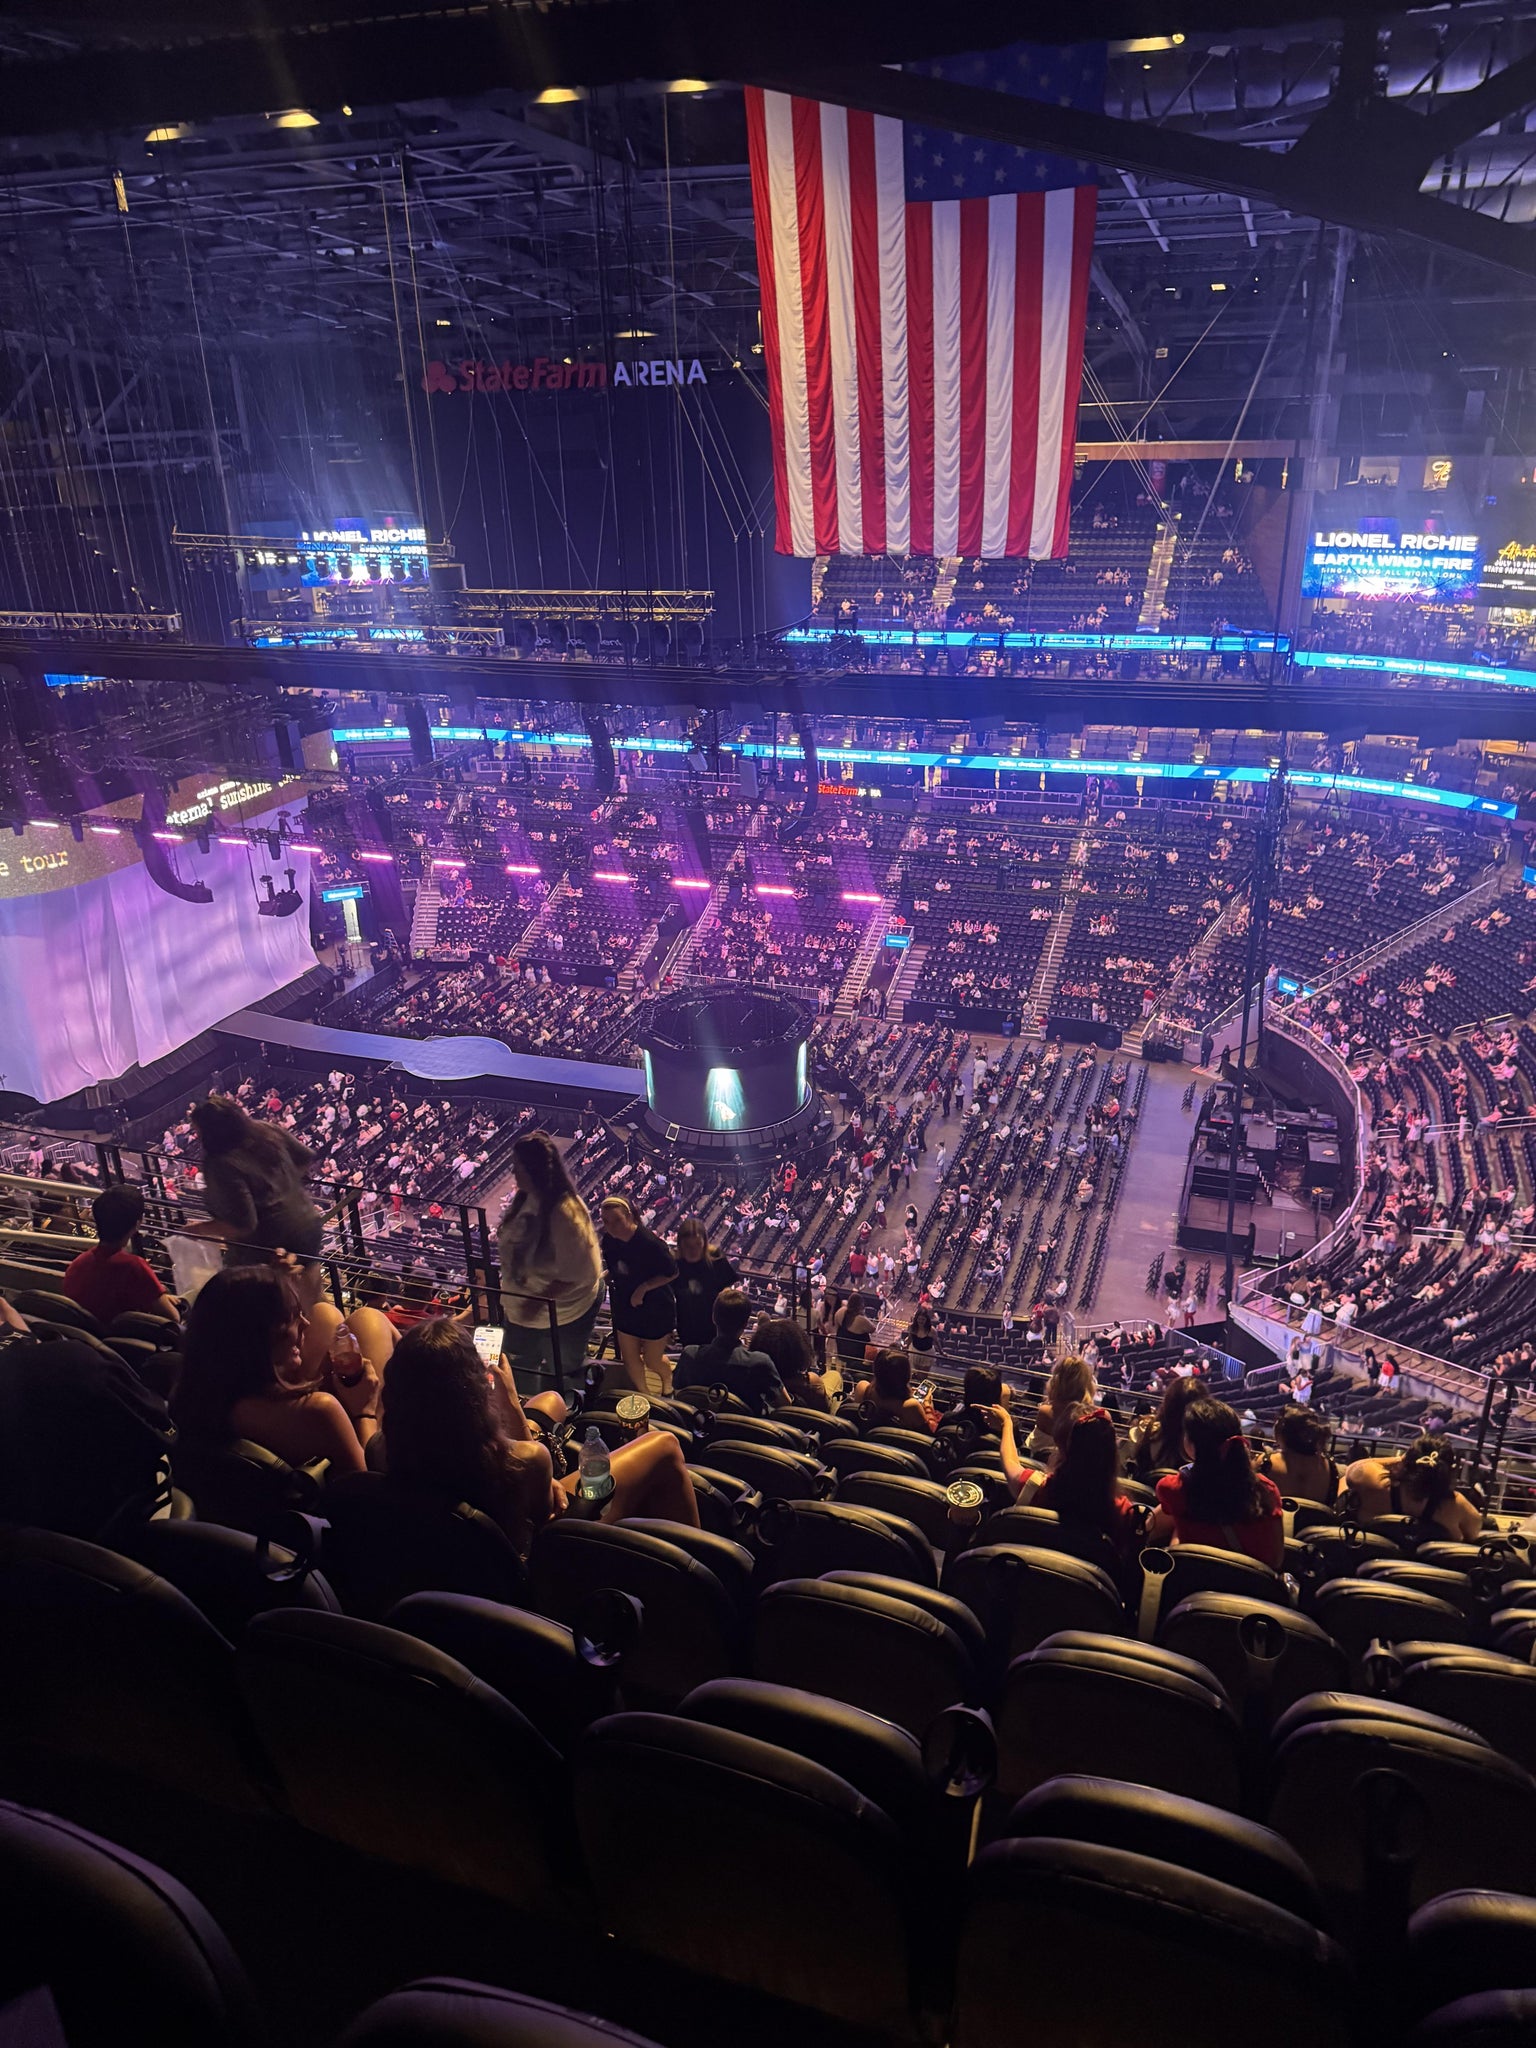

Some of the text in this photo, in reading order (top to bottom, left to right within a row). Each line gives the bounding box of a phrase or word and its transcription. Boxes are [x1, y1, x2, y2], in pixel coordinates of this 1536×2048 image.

[614, 360, 708, 386] ARENA
[370, 529, 427, 541] RICHIE
[1315, 532, 1395, 549] LIONEL
[1400, 534, 1478, 552] RICHIE
[1377, 555, 1422, 568] WIND
[1432, 557, 1473, 571] FIRE
[20, 851, 68, 873] tour
